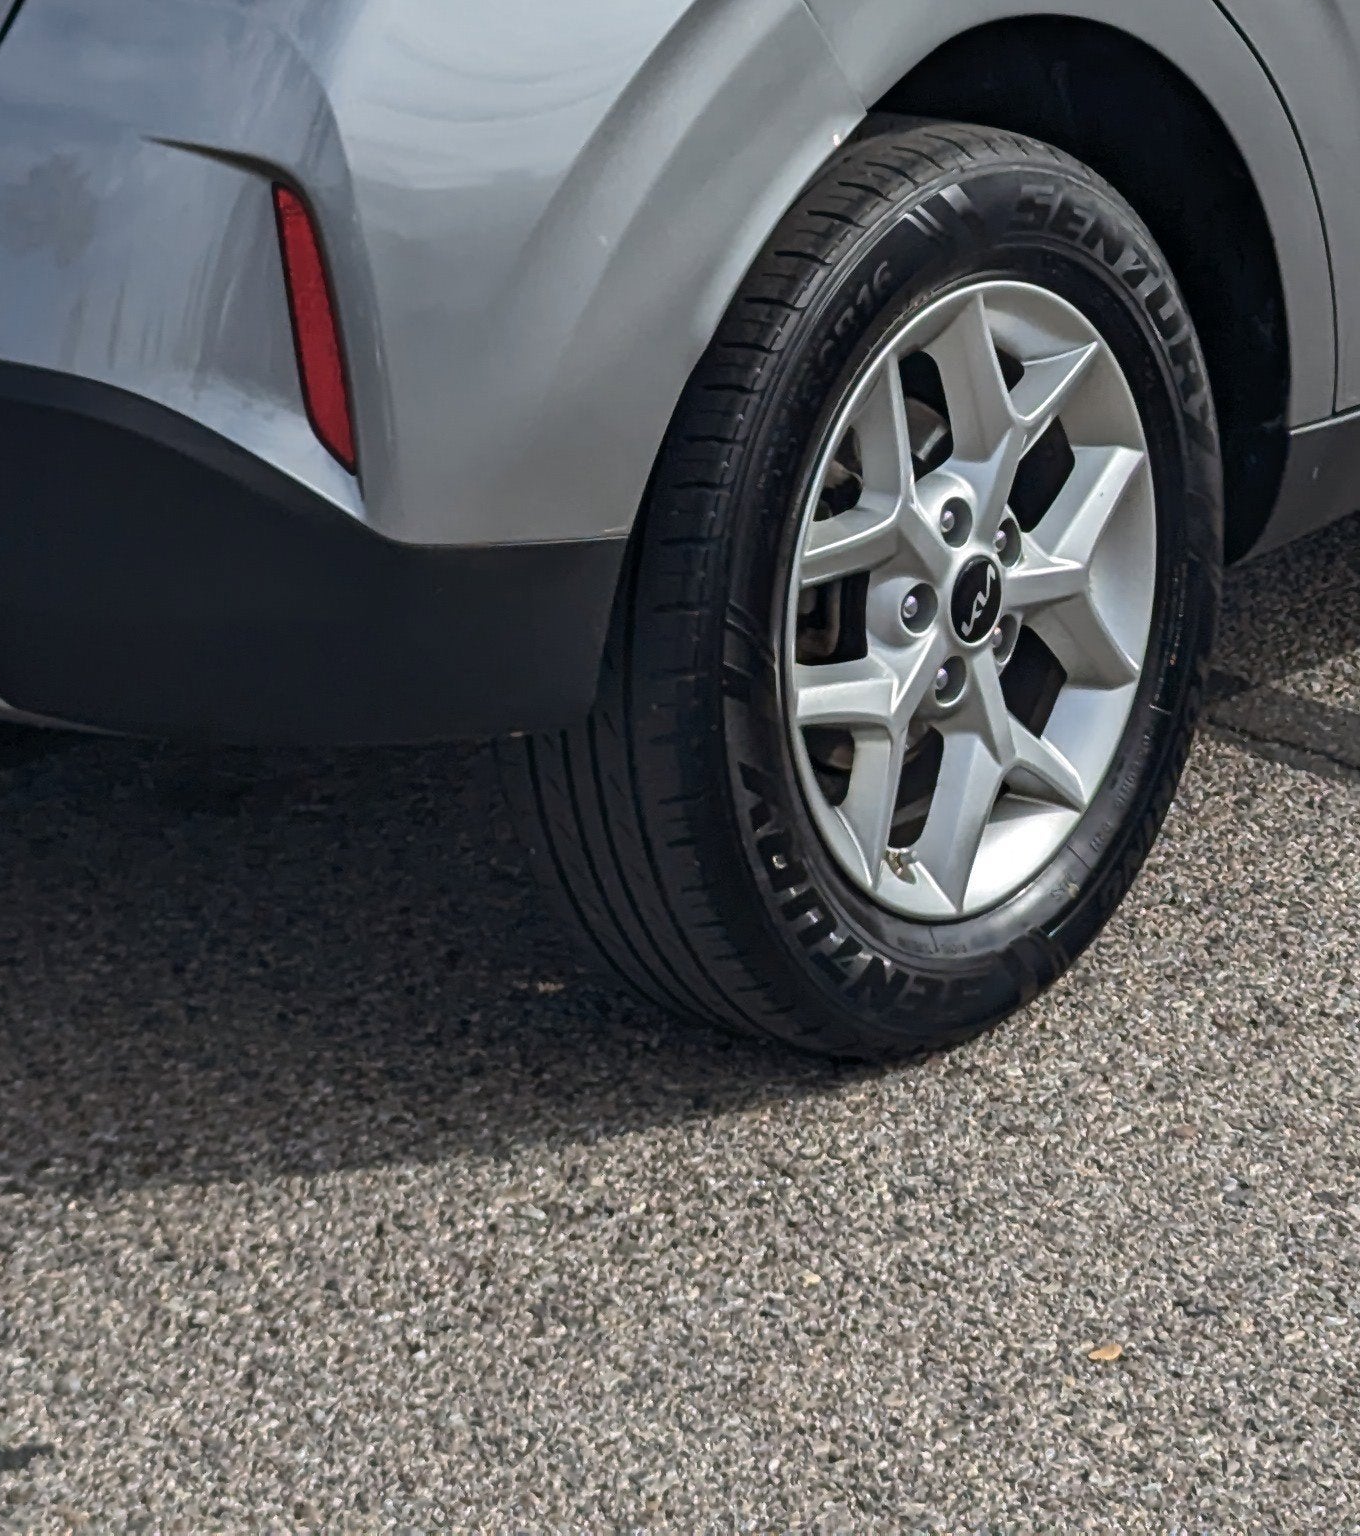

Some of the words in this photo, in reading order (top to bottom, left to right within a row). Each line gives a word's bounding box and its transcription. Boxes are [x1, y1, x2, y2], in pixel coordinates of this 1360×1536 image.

[1006, 180, 1216, 445] SENTURY
[961, 563, 996, 637] KIA
[737, 761, 986, 1024] SENTURY
